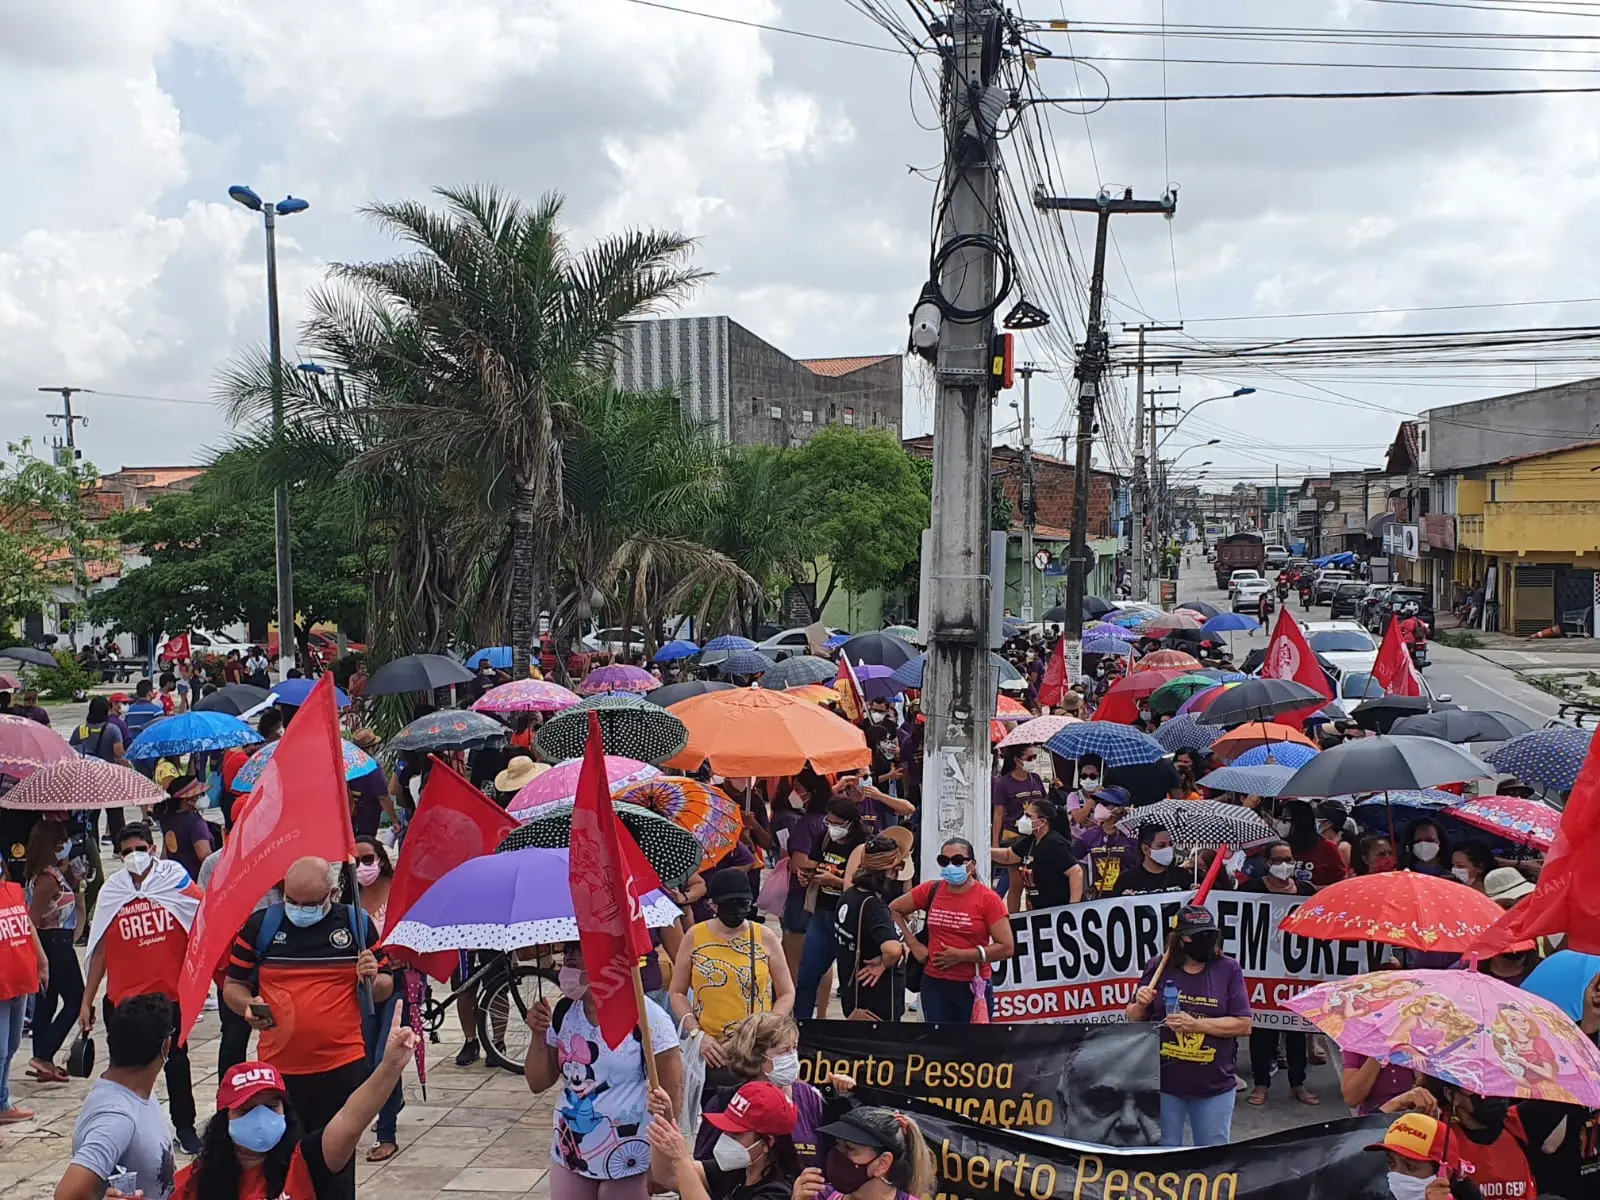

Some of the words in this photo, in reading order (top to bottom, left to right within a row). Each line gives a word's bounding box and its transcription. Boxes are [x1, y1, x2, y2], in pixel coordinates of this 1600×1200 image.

[0, 914, 32, 941] REVE
[119, 909, 174, 941] GREVE
[992, 900, 1182, 986] FESSORE
[1217, 899, 1270, 972] EM
[1065, 988, 1092, 1012] NA
[1101, 983, 1137, 1007] RU
[1250, 982, 1267, 1004] A
[1252, 1012, 1279, 1024] NTO
[1282, 1015, 1298, 1026] DE
[799, 1051, 894, 1087] oberto
[905, 1053, 1015, 1089] Pessoa
[941, 1138, 1056, 1200] berto
[1073, 1154, 1239, 1200] Pessoa
[1479, 1182, 1503, 1198] NDO
